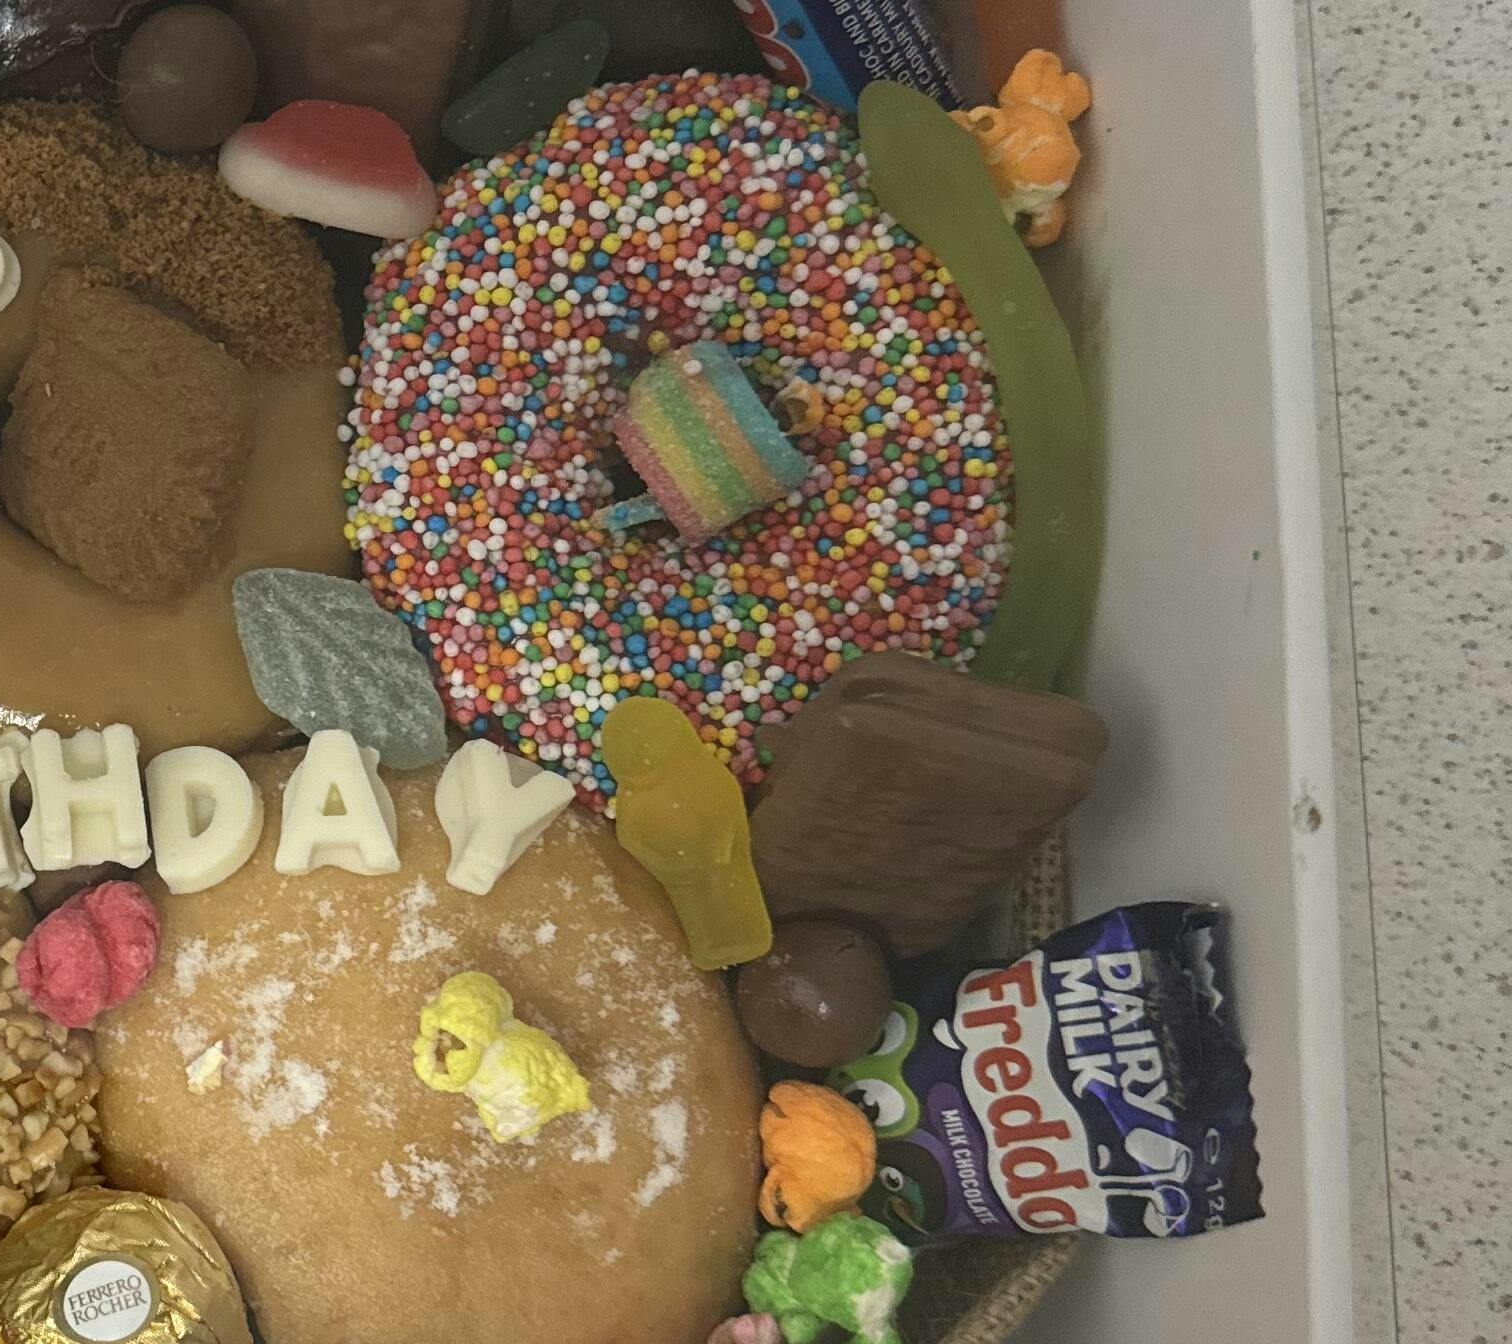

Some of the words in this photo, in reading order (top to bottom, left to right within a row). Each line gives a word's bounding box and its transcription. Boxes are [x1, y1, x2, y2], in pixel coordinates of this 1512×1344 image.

[840, 12, 868, 47] AND
[891, 21, 934, 85] CADBURY
[1049, 958, 1119, 1099] MILK
[1095, 951, 1175, 1122] DAIRY
[961, 960, 1090, 1229] Freddo
[940, 1108, 970, 1147] MILK
[952, 1148, 1001, 1225] CHOCOLATE
[67, 1273, 143, 1312] FERRERO
[72, 1289, 148, 1327] ROCHER
